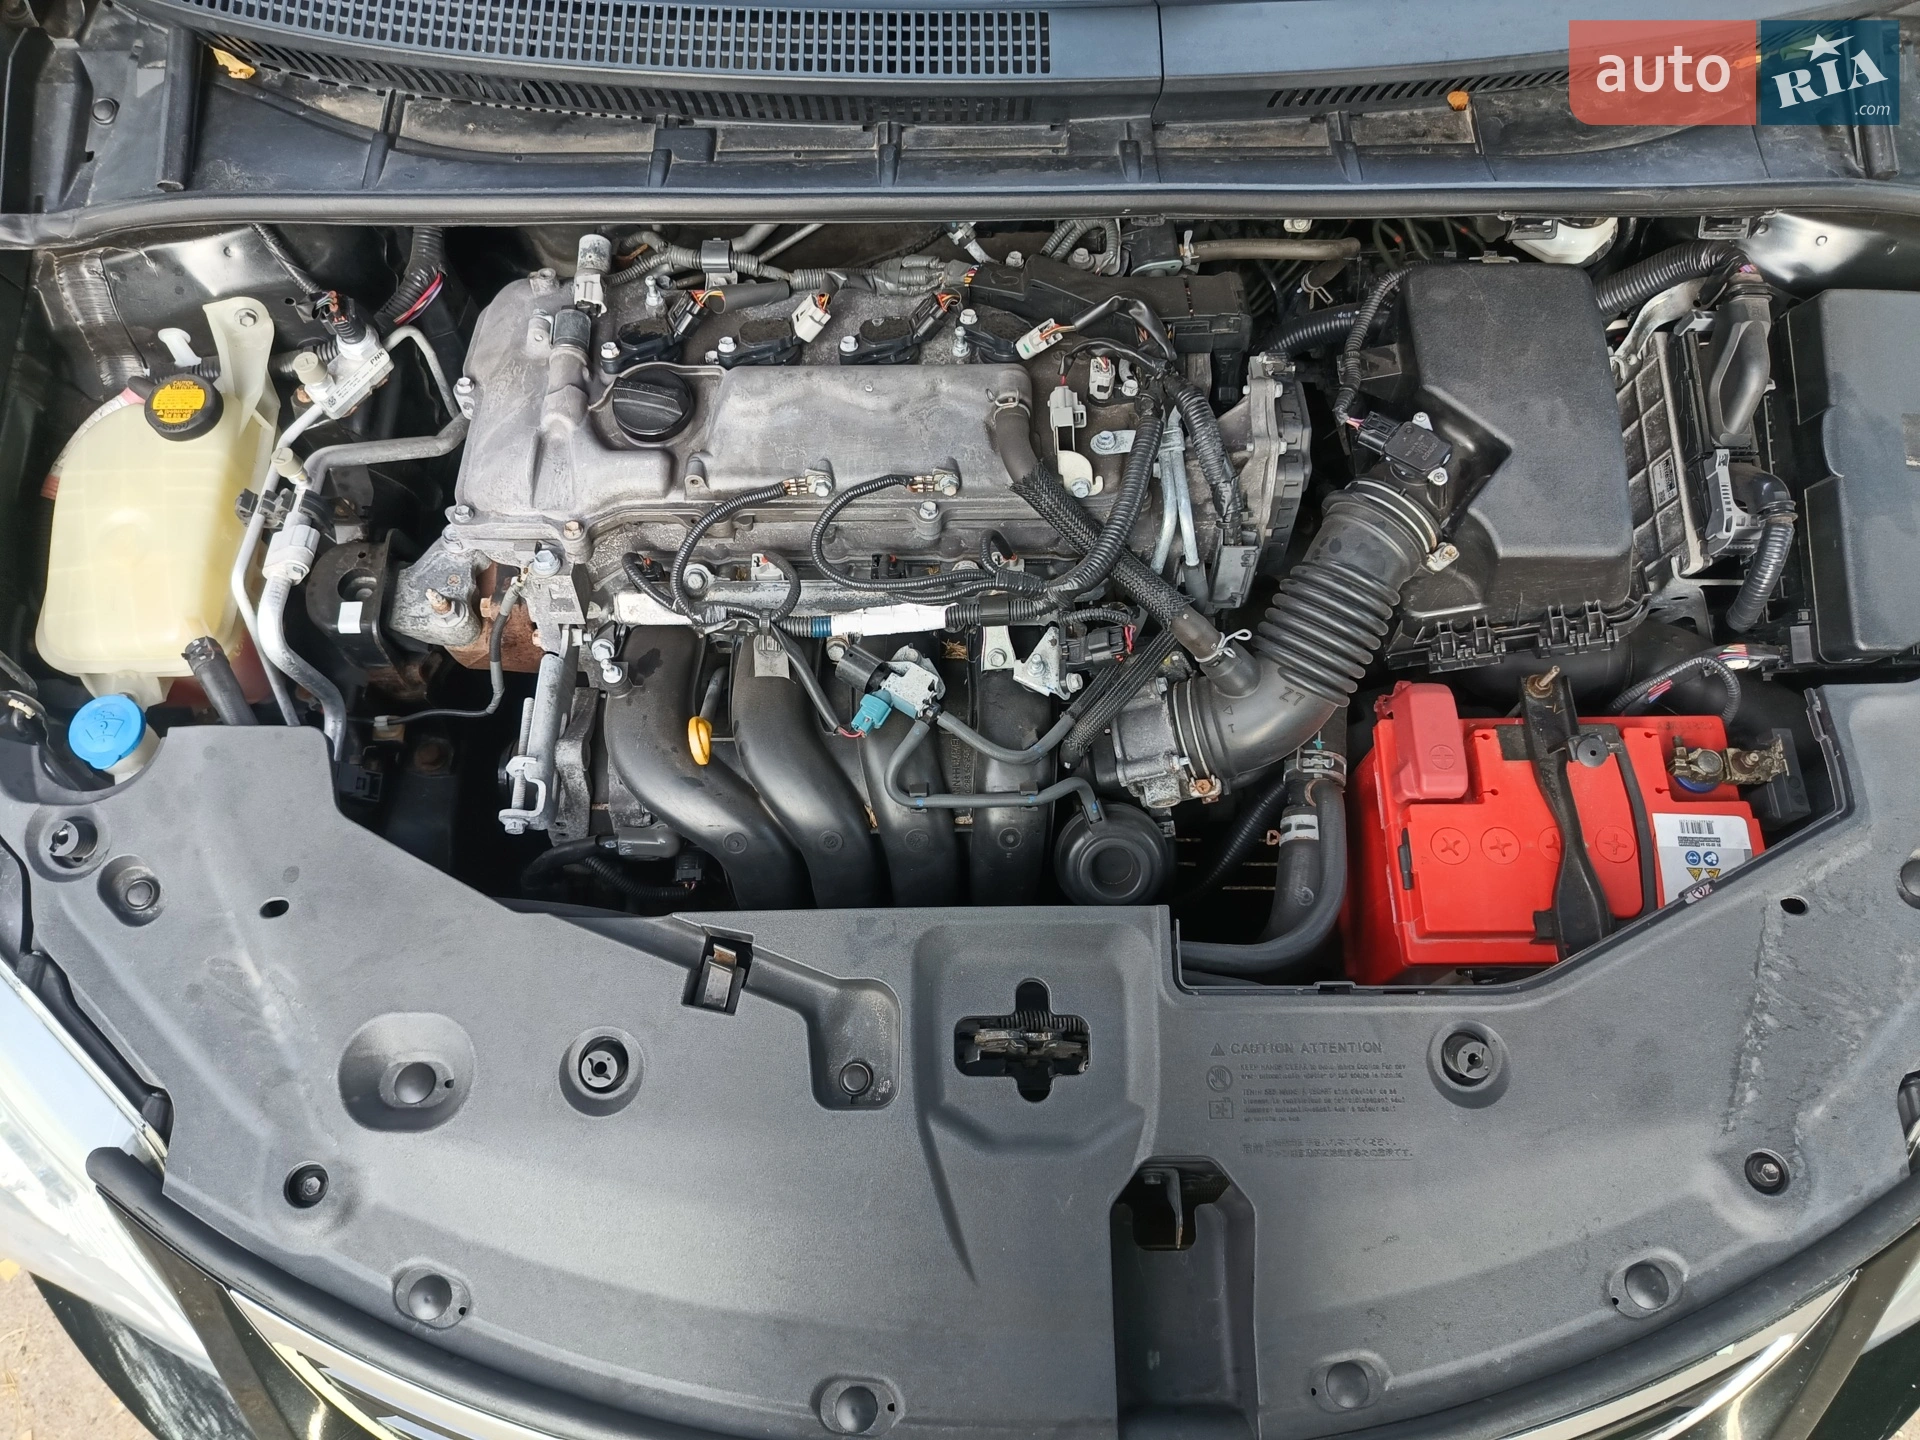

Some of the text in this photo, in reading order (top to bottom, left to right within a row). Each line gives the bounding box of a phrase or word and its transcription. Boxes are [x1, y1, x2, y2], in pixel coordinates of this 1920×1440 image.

[370, 351, 385, 364] PNK
[1230, 1042, 1382, 1054] CAUTION ATTENTION
